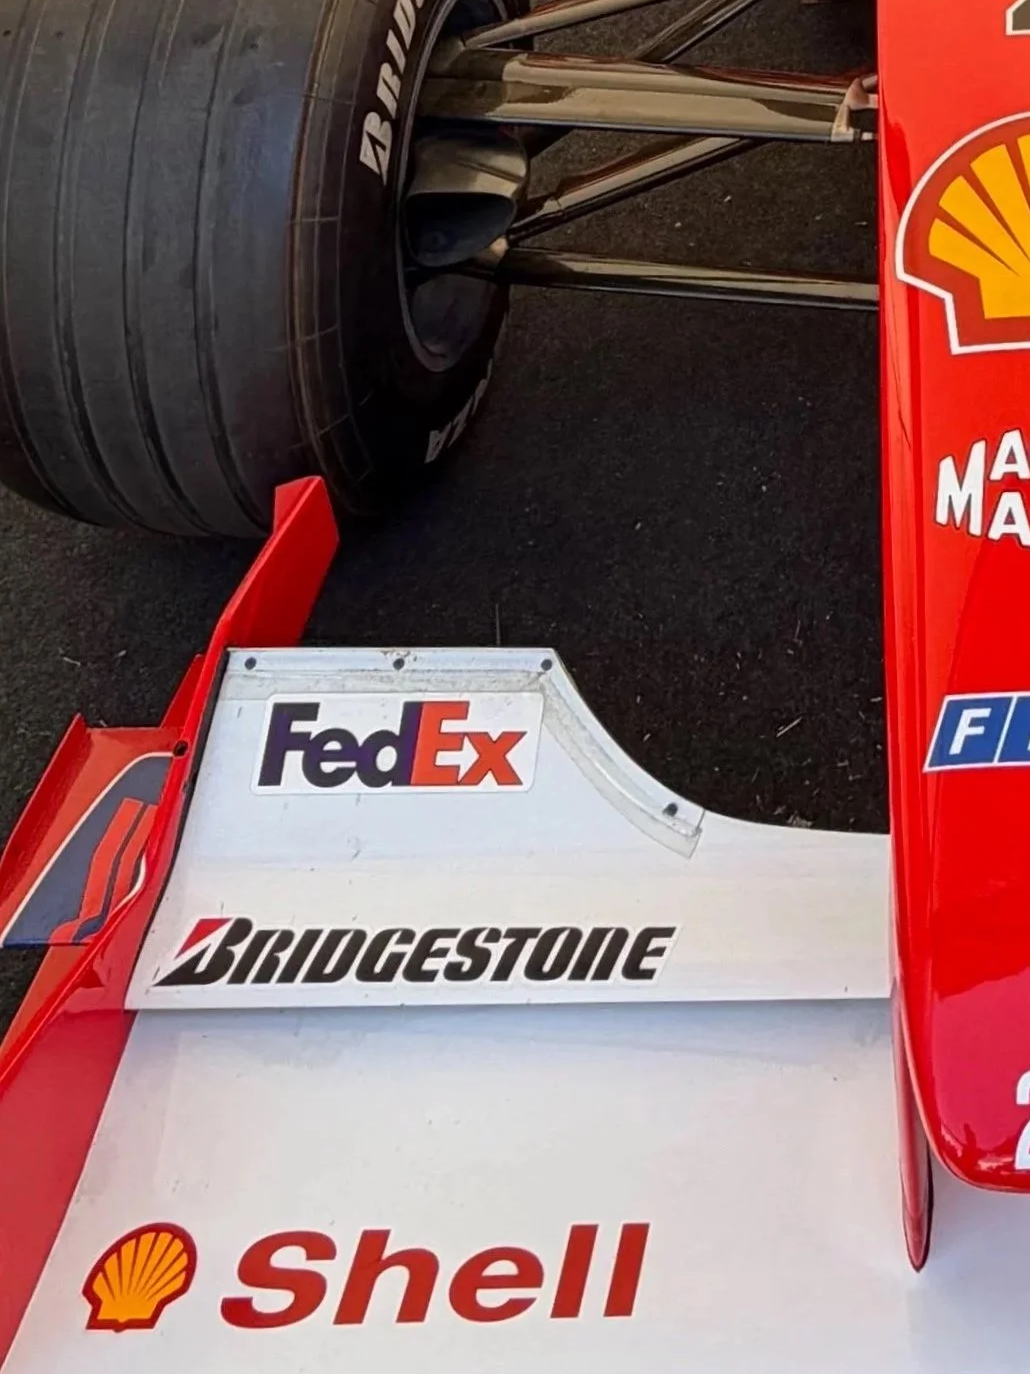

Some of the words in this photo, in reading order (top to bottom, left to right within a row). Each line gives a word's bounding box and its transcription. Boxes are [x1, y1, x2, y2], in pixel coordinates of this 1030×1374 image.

[257, 701, 527, 788] FedEx
[153, 917, 676, 986] BRIDGESTONE
[219, 1222, 651, 1330] Shell
